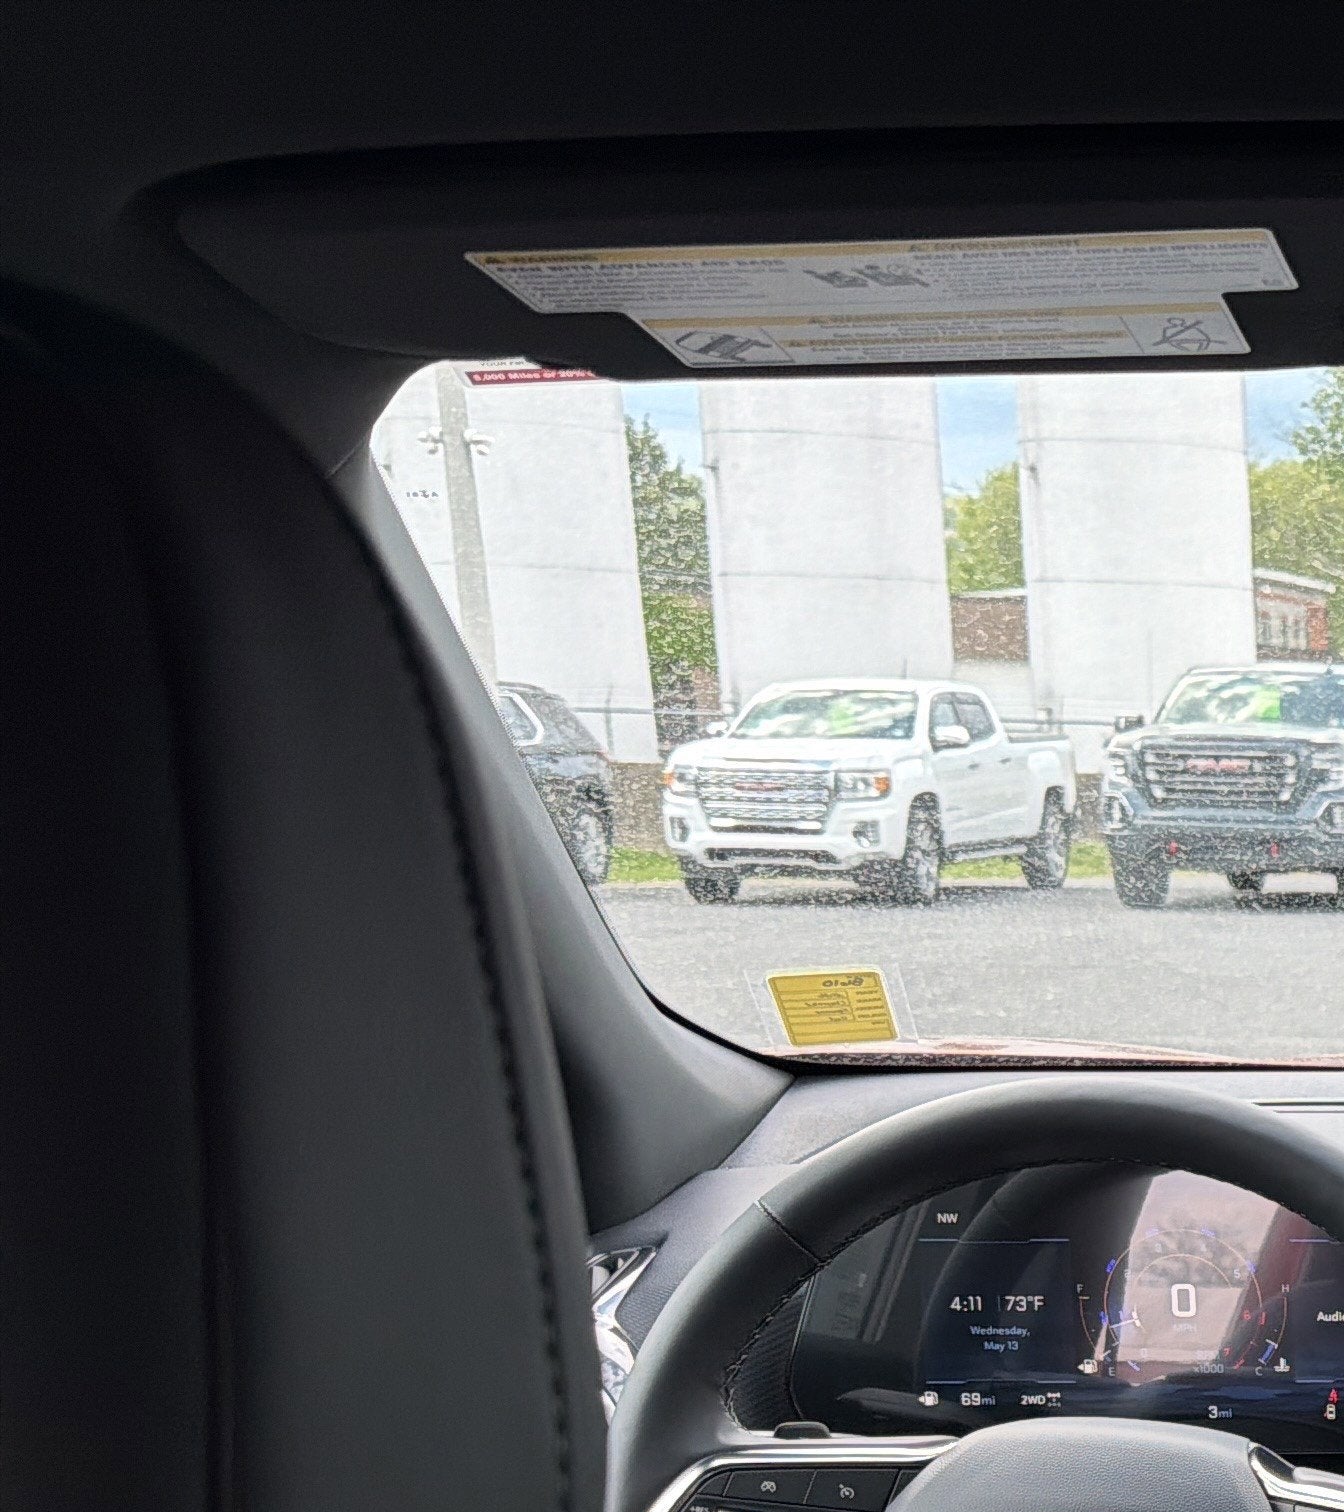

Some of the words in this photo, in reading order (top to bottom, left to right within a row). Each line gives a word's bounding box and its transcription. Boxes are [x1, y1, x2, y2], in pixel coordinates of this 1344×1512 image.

[936, 1213, 959, 1224] NW
[1233, 1270, 1240, 1279] 5
[1076, 1284, 1084, 1294] F
[1282, 1284, 1290, 1293] H
[950, 1296, 982, 1312] 4:11
[1004, 1296, 1045, 1312] 73°F
[1171, 1284, 1197, 1318] 0
[970, 1325, 1031, 1337] Wednesday,
[1173, 1324, 1197, 1332] MPH
[984, 1341, 1005, 1354] May
[1007, 1341, 1019, 1351] 13
[1108, 1367, 1116, 1377] E
[1255, 1367, 1263, 1377] C
[1020, 1395, 1046, 1406] 2WD
